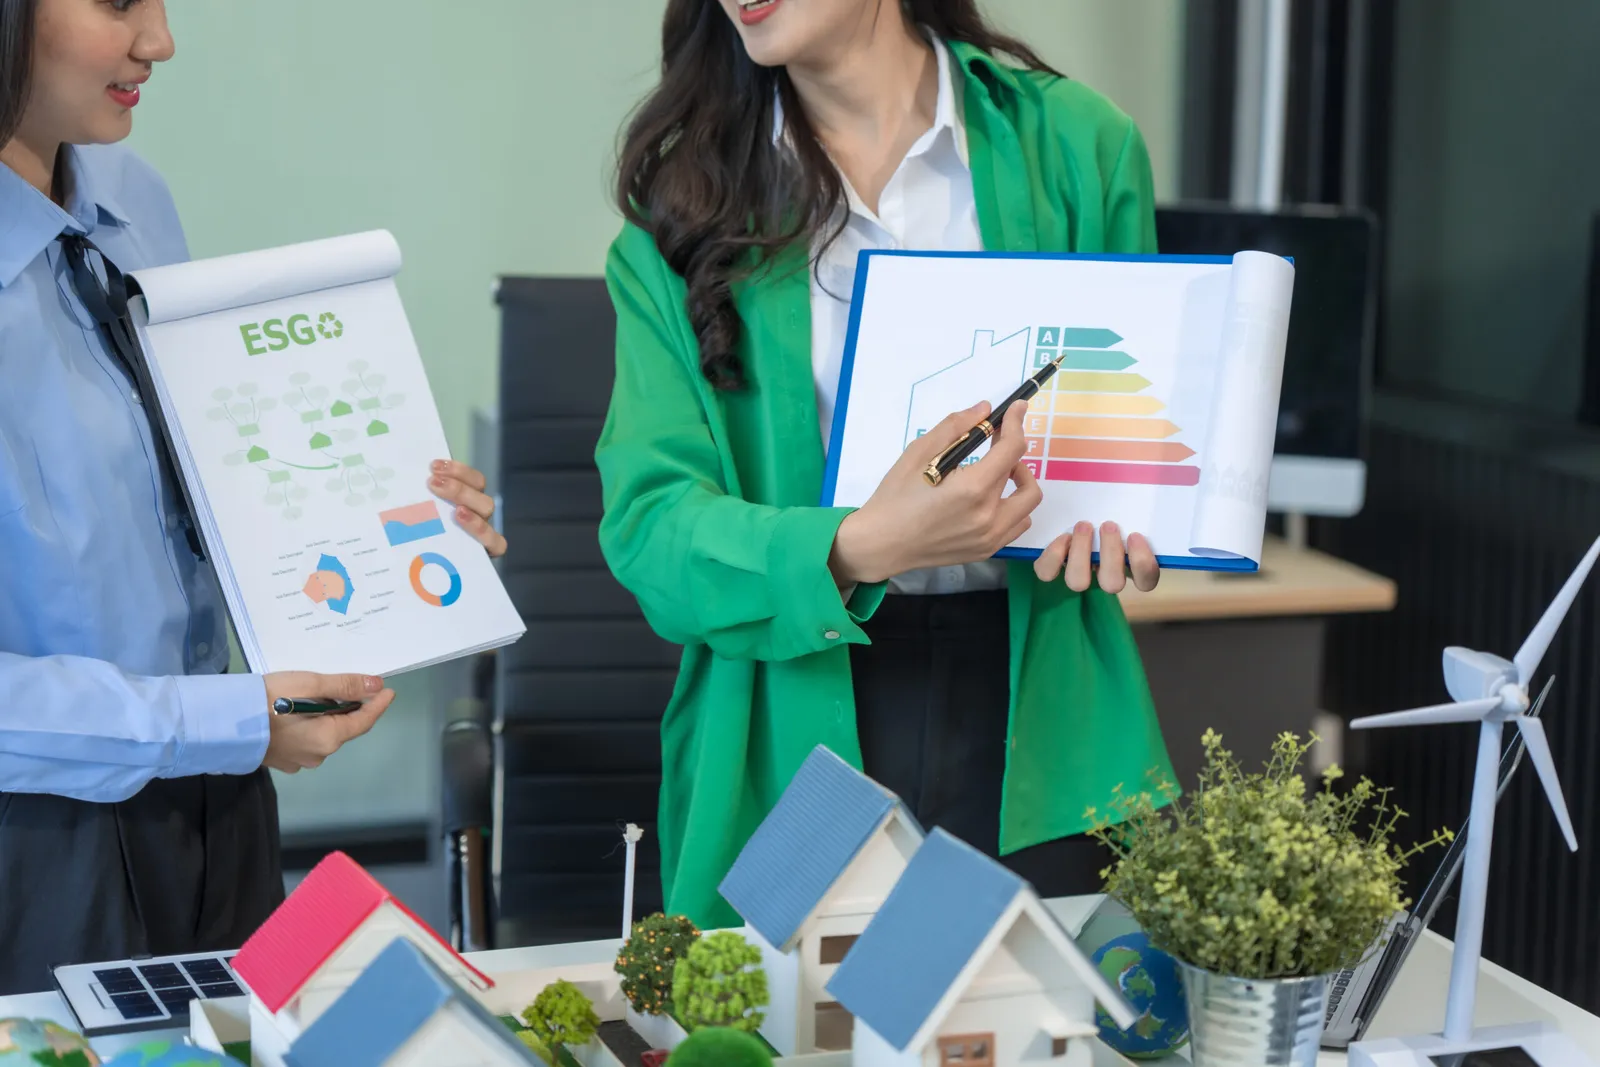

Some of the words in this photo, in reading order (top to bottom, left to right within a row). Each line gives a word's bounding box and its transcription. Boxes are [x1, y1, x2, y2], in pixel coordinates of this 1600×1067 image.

[239, 313, 317, 356] ESG
[1041, 330, 1053, 343] A
[1039, 352, 1051, 365] B
[1031, 418, 1042, 431] E
[1027, 440, 1038, 453] F
